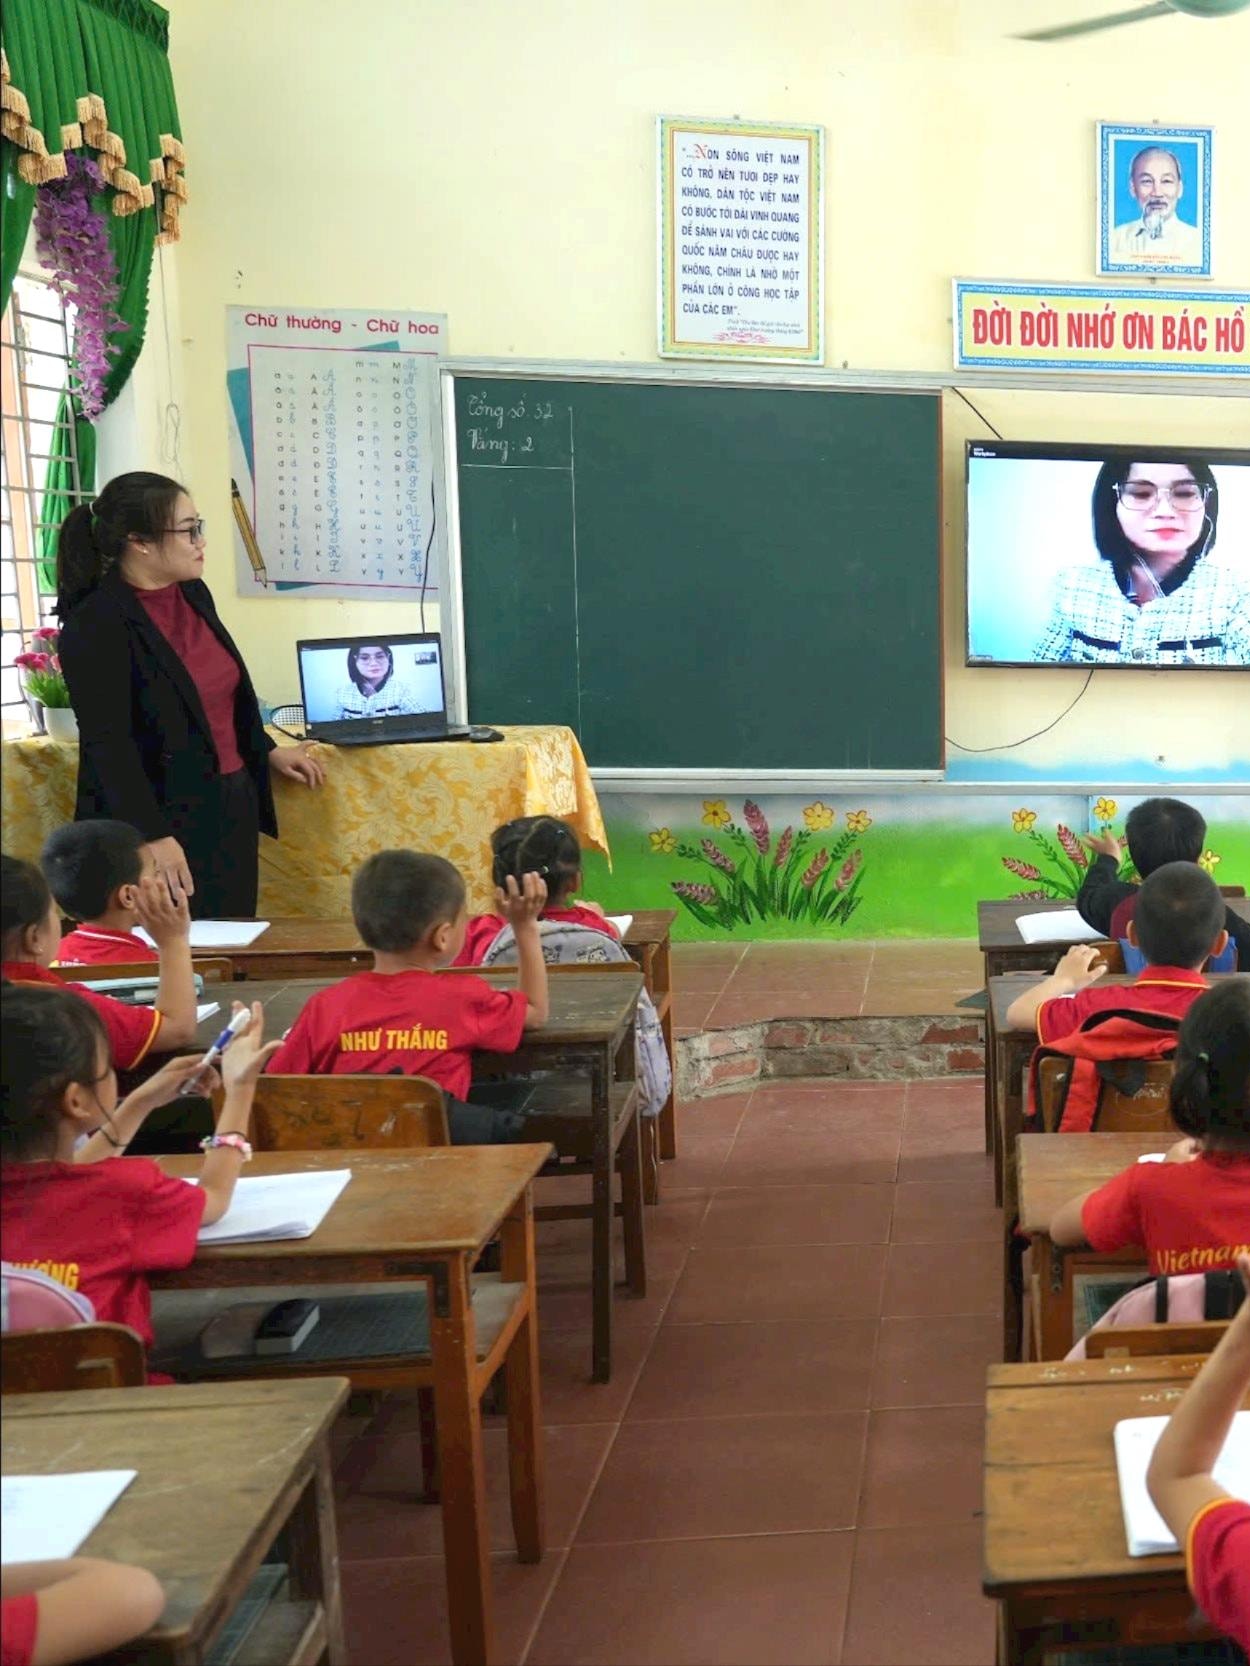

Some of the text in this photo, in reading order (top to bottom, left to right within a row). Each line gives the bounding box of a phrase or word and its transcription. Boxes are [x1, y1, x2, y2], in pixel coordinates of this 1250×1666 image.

[726, 148, 749, 161] SÔNG
[756, 152, 773, 166] VIỆT
[781, 154, 800, 164] NAM
[245, 312, 439, 334] Chữ thường Chữ hoa
[973, 300, 1011, 346] ĐỜI
[1020, 302, 1059, 347] ĐỜI
[1067, 301, 1117, 349] NHỚ
[1123, 311, 1154, 350] ƠN
[1163, 308, 1207, 352] BÁC
[1216, 305, 1244, 353] HỒ
[521, 437, 534, 452] 2
[341, 1023, 447, 1051] NHƯ THẮNG
